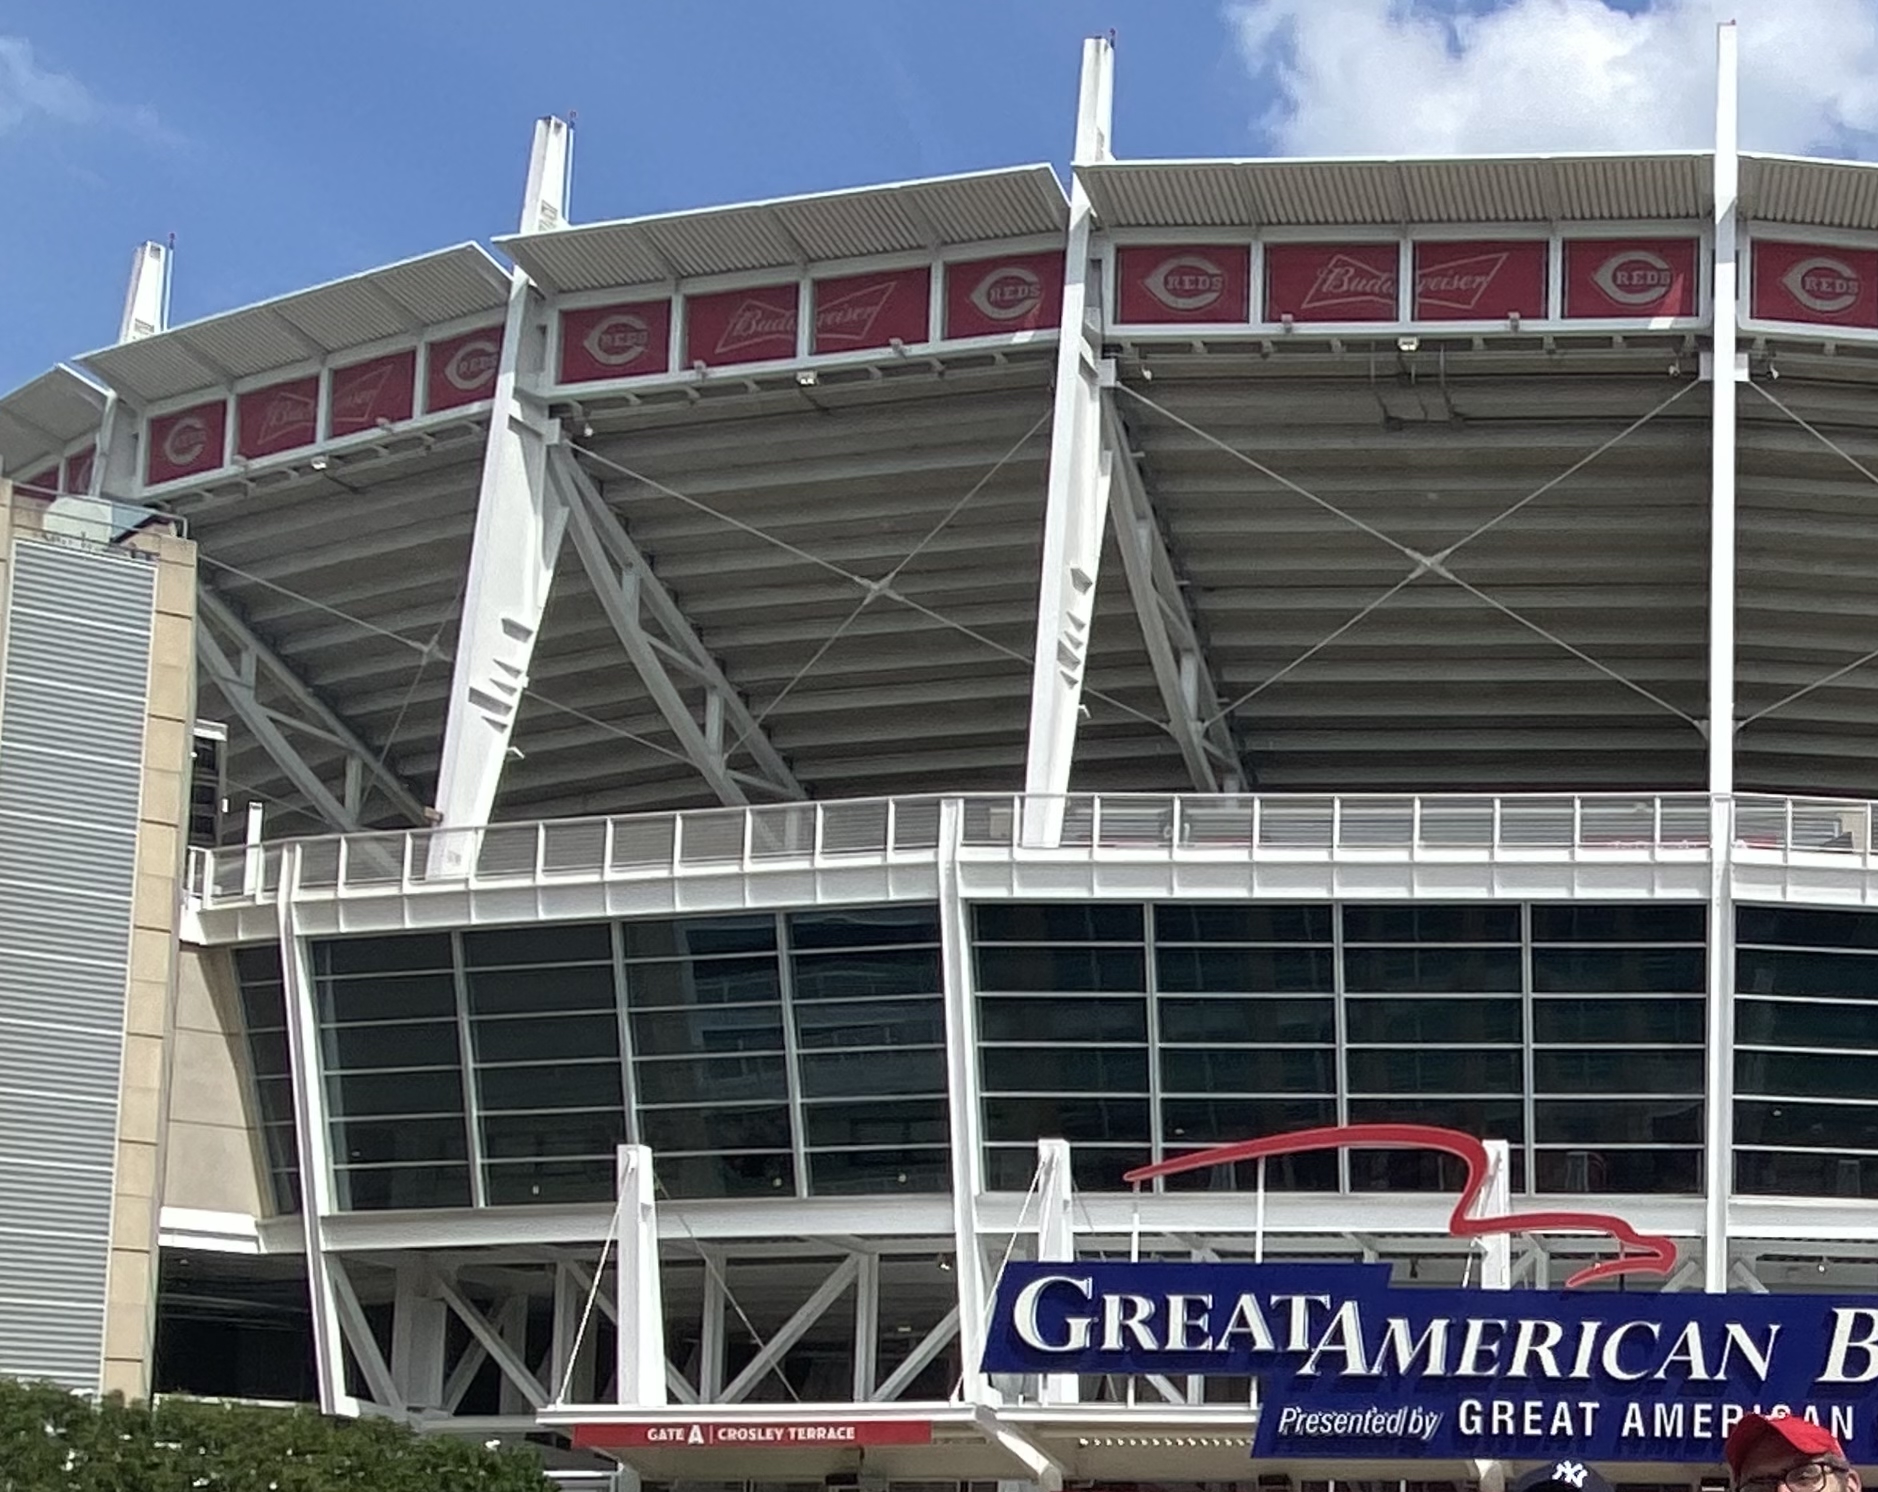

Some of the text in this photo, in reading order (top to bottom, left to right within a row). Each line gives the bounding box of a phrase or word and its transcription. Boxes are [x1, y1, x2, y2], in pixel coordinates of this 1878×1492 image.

[1166, 274, 1223, 291] REDS
[1616, 269, 1671, 286] REDS
[1804, 276, 1859, 295] REDS
[988, 281, 1041, 302] REDS
[1013, 1275, 1332, 1352] GREAT
[1297, 1301, 1780, 1381] AMERICAN
[1278, 1406, 1408, 1436] Presented
[1408, 1406, 1444, 1440] by
[1459, 1399, 1600, 1436] GREAT
[1621, 1402, 1853, 1440] AMERAN
[647, 1424, 856, 1445] GATE A CROSLEY TERRACE
